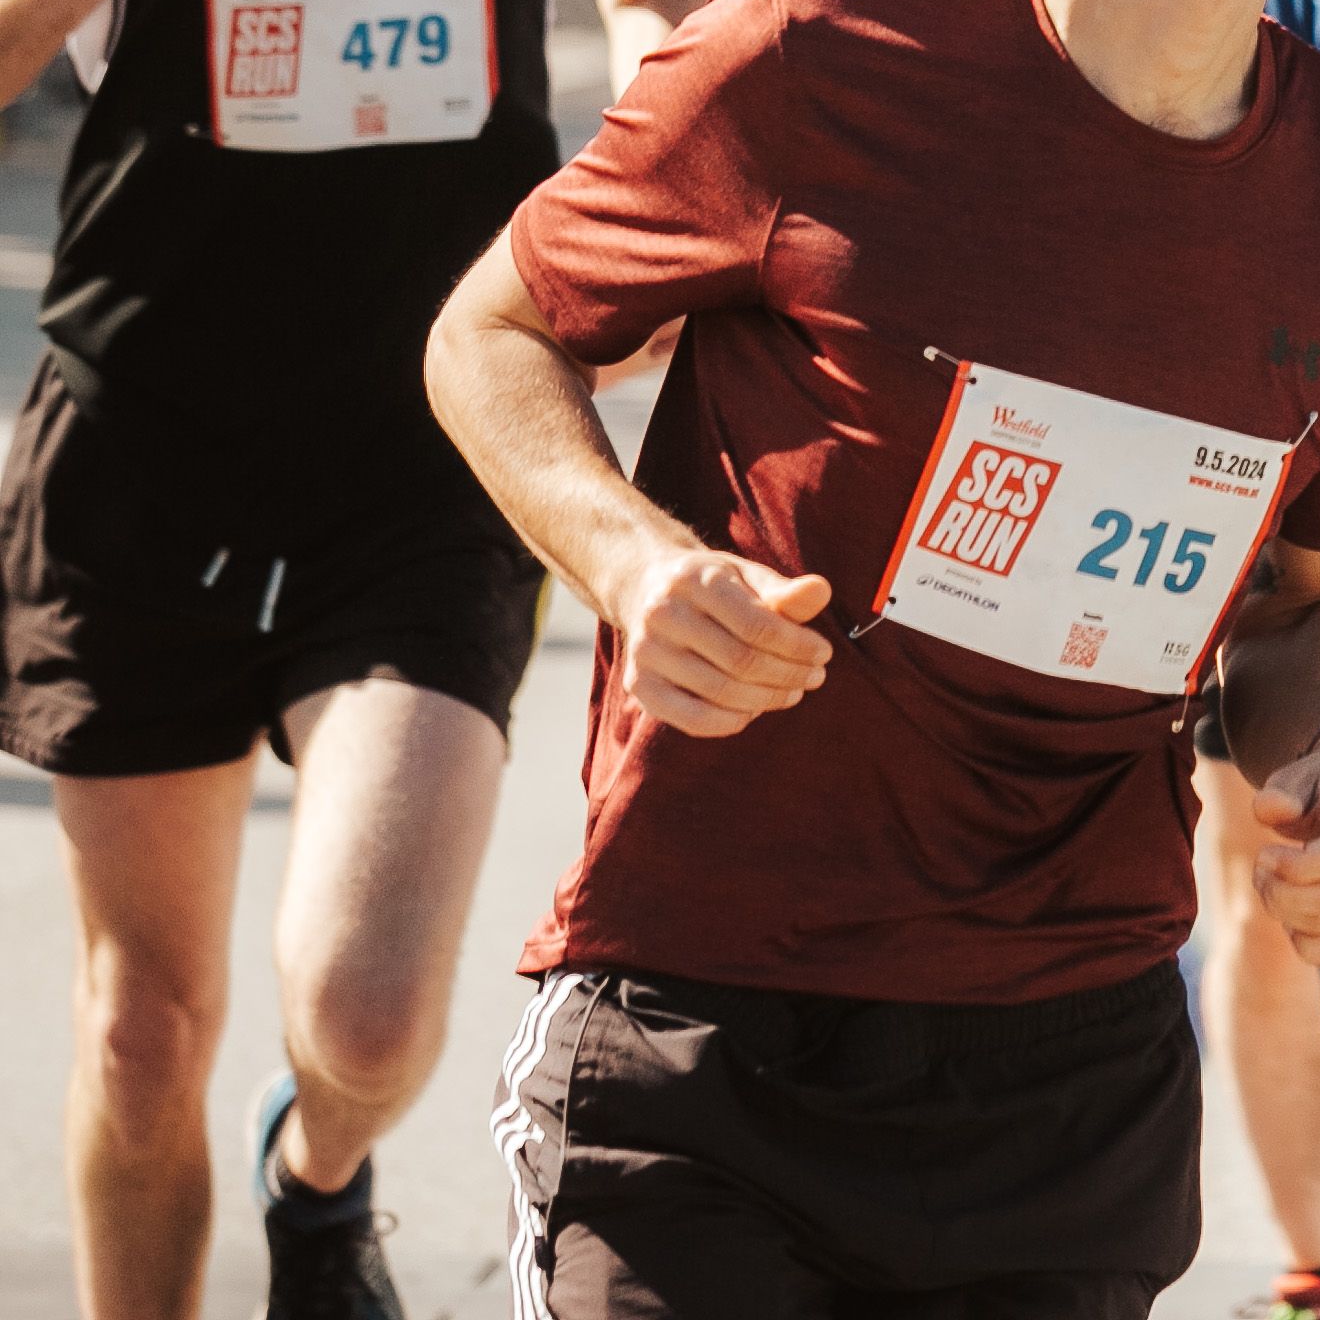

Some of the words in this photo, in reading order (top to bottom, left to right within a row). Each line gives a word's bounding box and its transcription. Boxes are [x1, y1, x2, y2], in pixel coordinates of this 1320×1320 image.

[233, 8, 297, 54] SCS
[341, 13, 450, 70] 479
[958, 447, 1050, 518] SCS
[1194, 446, 1267, 480] 9.5.2024
[929, 502, 1029, 573] RUN
[1075, 508, 1216, 595] 215
